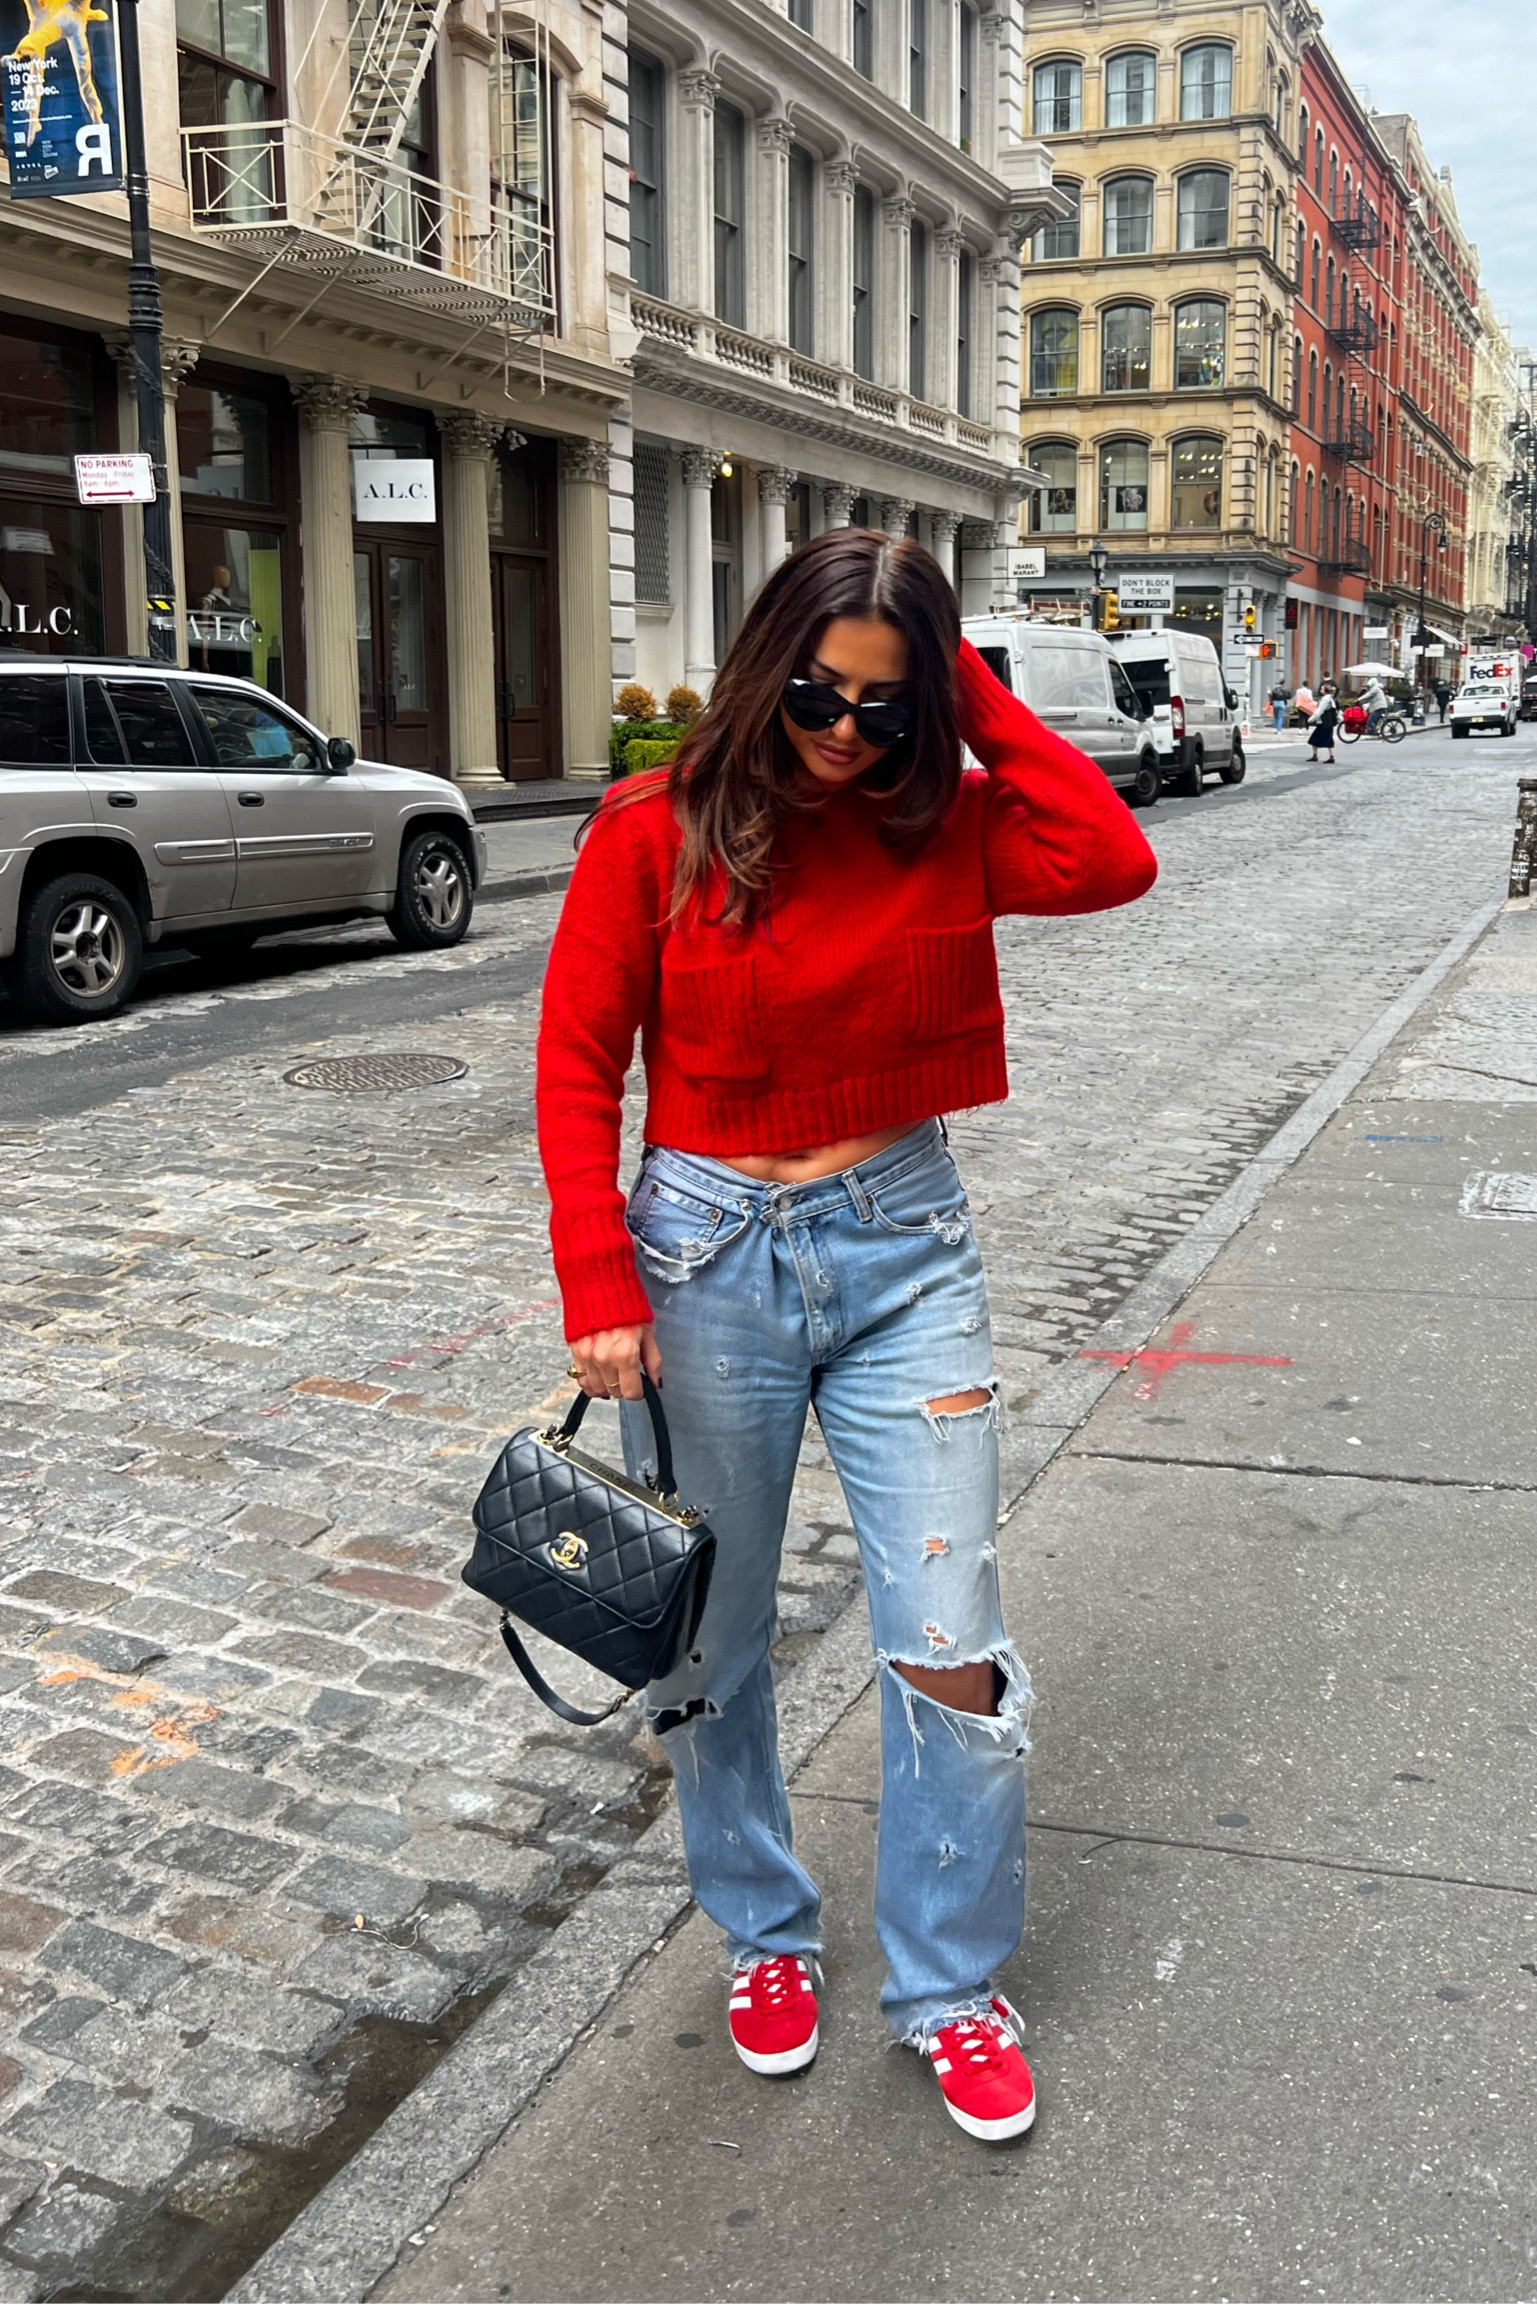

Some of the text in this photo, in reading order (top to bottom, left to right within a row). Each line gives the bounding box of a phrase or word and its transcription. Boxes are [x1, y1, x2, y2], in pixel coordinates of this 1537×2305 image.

[8, 56, 58, 73] New York
[9, 72, 45, 86] 19 Oct.
[36, 84, 60, 97] Dec.
[81, 459, 134, 469] NO PARKING
[82, 470, 134, 479] Monday Friday
[363, 482, 428, 499] A.L.C.
[1122, 579, 1171, 587] DON'T BLOCK
[0, 604, 79, 636] .L.C.
[189, 614, 263, 643] A.L.C.
[1470, 663, 1514, 680] FedEx
